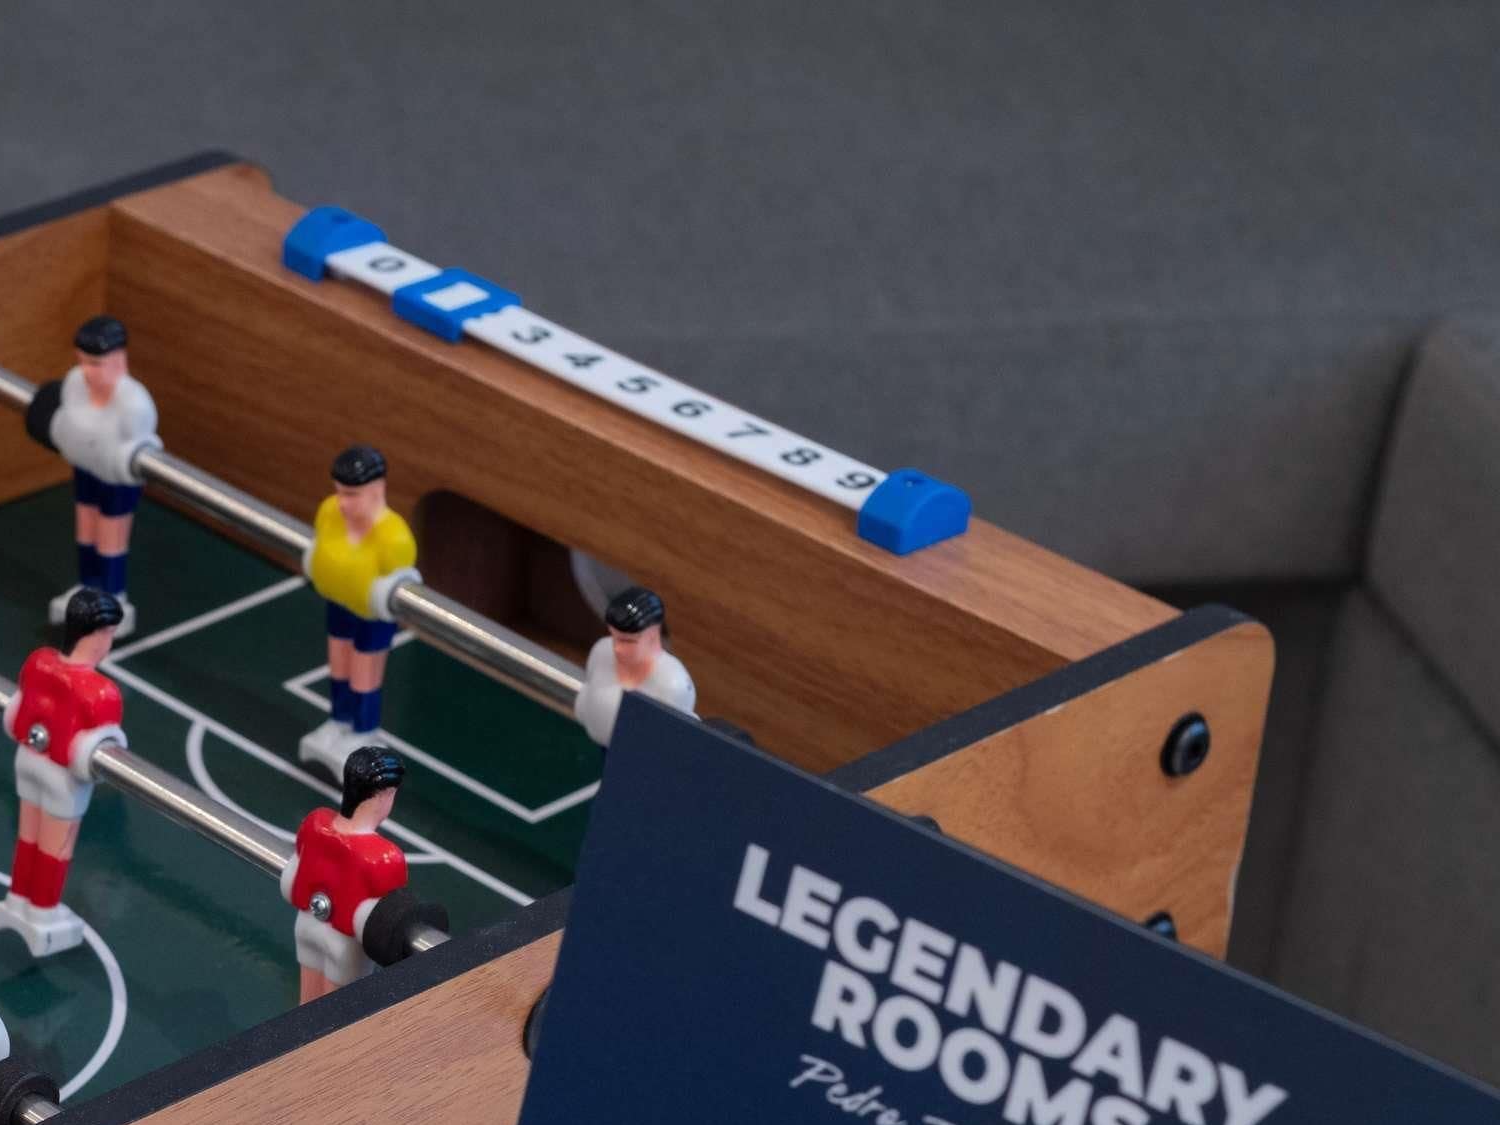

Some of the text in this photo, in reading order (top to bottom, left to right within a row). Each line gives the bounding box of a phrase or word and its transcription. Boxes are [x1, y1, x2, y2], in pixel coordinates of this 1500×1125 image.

[369, 256, 876, 491] 0 3 4 5 6 7 8 9
